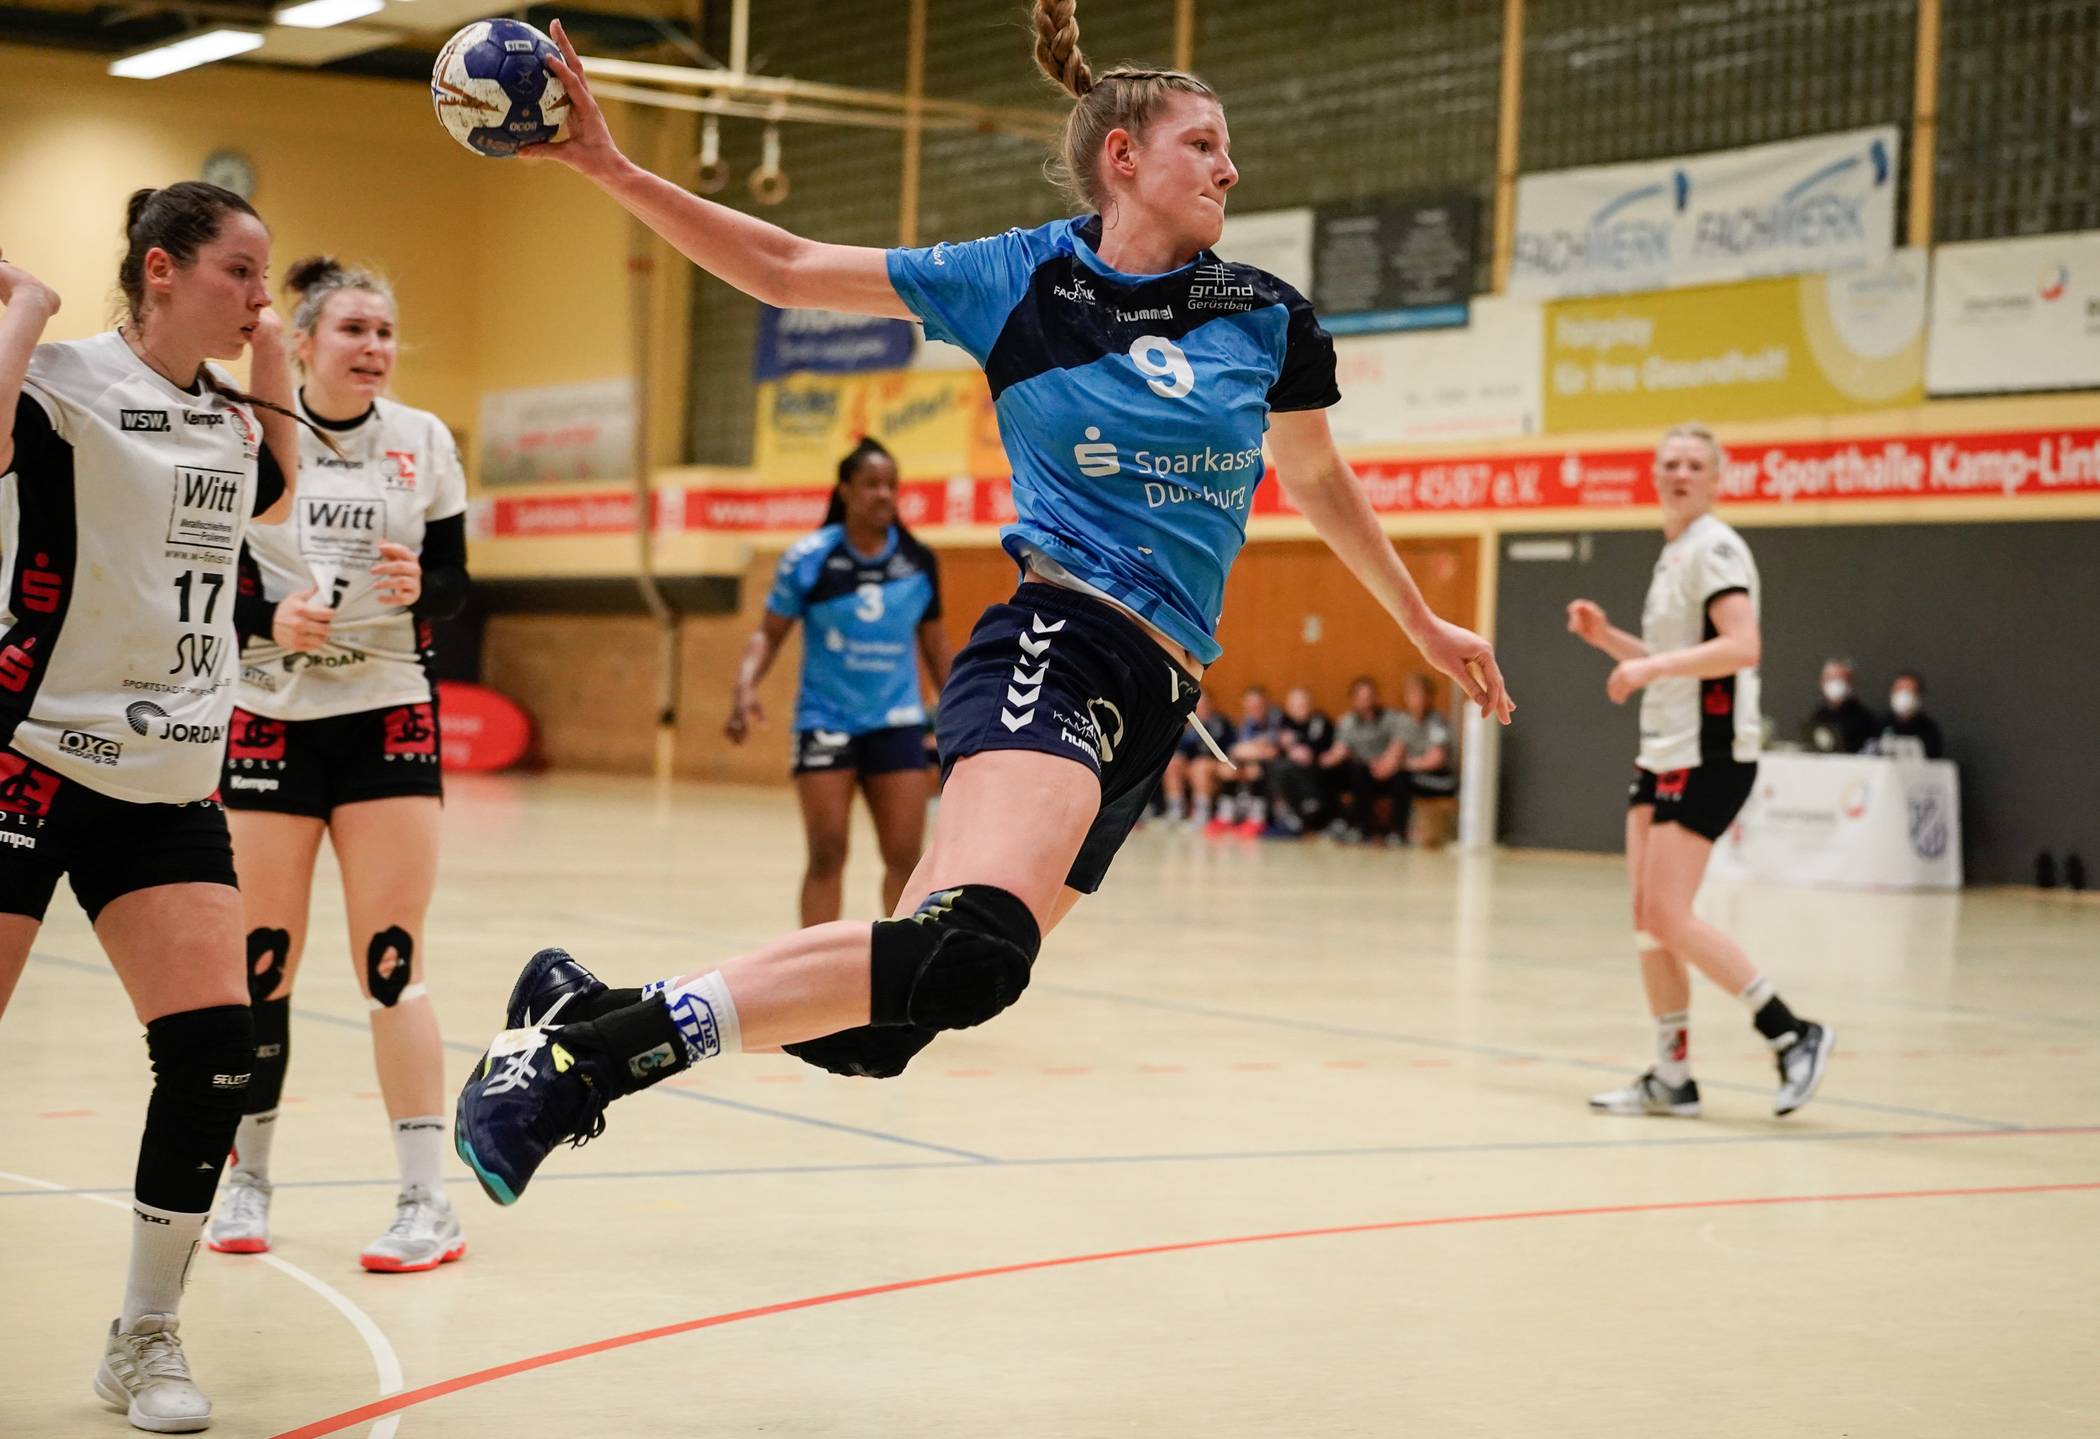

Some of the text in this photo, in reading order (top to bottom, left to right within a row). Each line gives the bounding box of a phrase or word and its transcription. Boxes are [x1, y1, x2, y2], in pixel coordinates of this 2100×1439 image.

[1115, 305, 1174, 323] hummel
[1188, 299, 1252, 312] Gerüstbau
[1129, 335, 1195, 399] 9
[182, 409, 225, 429] Kempa
[1135, 446, 1261, 479] Sparkasse
[1760, 441, 1924, 501] Sporthalle
[183, 473, 237, 513] Witt
[308, 502, 376, 531] Witt
[173, 569, 224, 624] 17
[855, 582, 885, 622] 3
[159, 722, 223, 744] JORDA
[230, 775, 280, 794] Kempa
